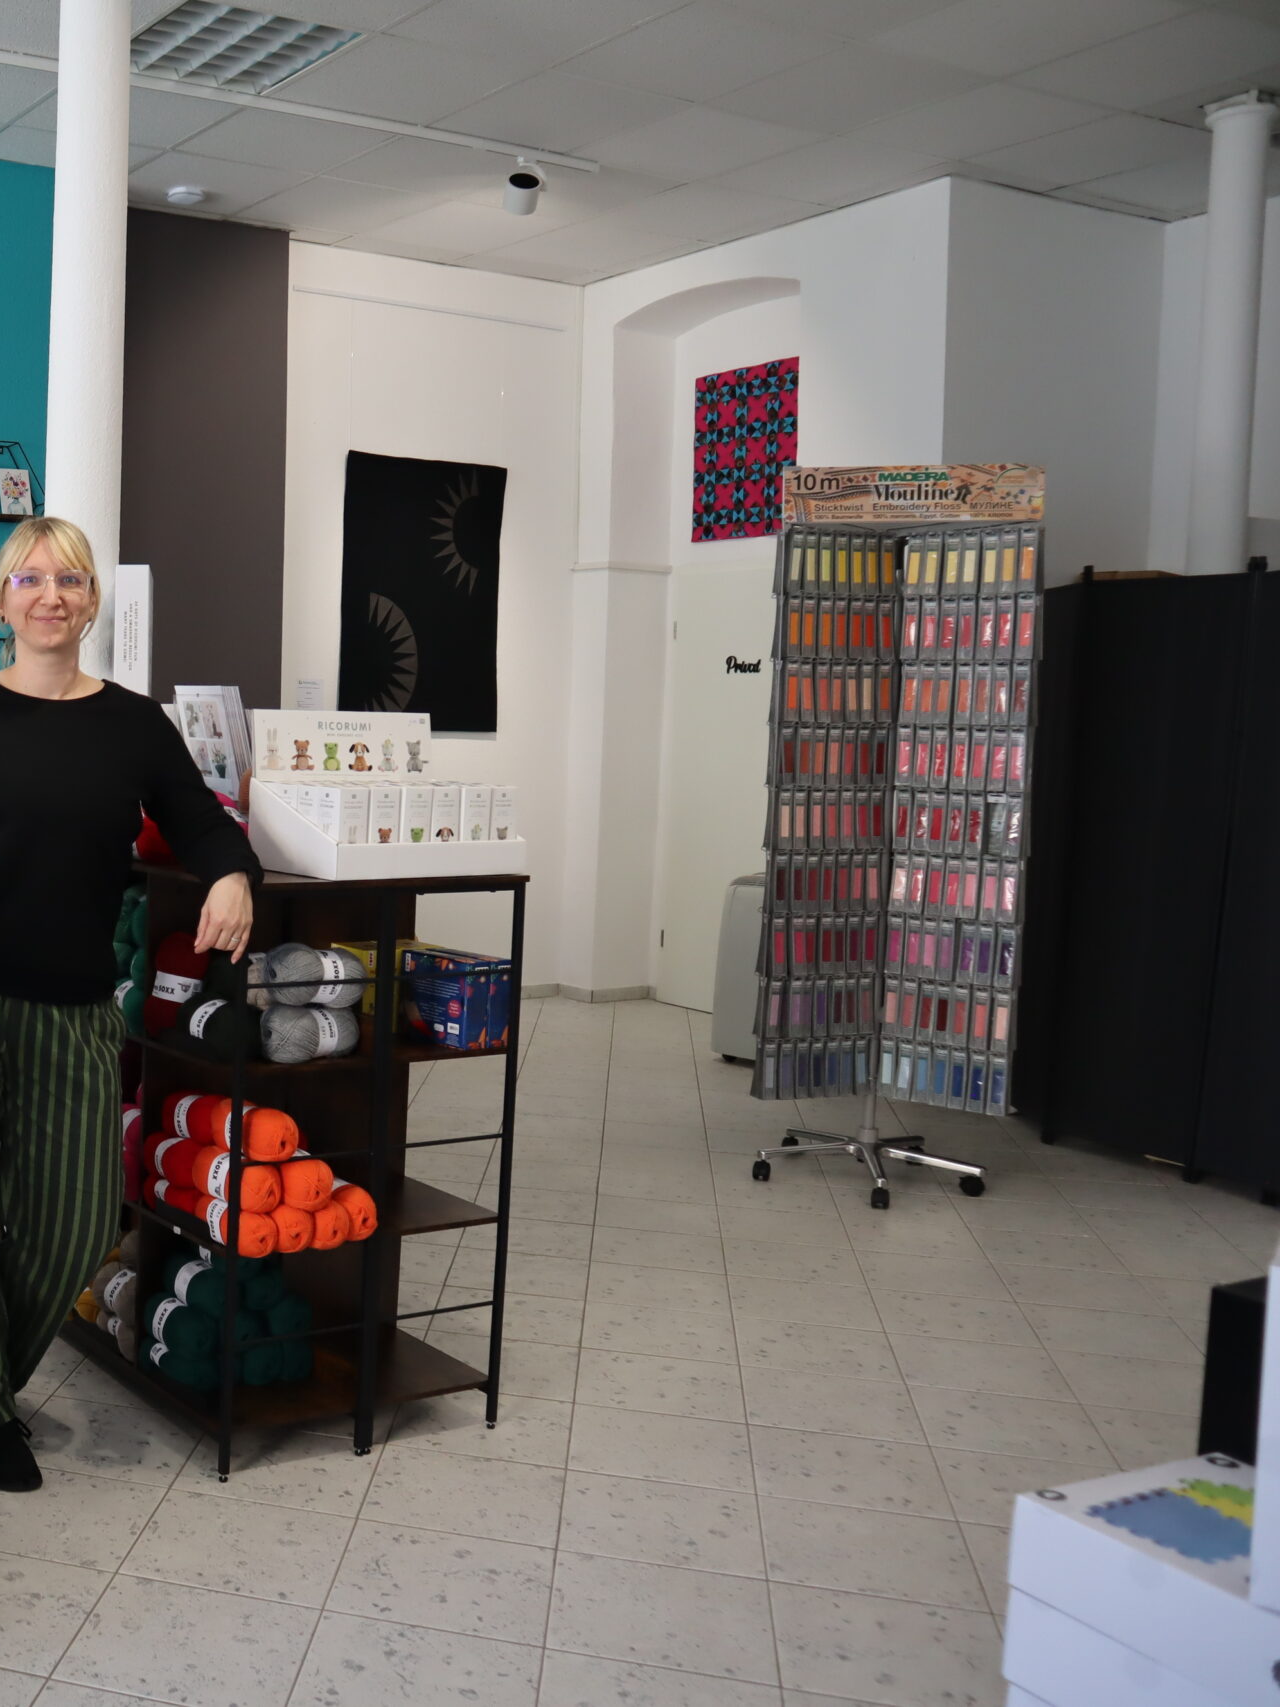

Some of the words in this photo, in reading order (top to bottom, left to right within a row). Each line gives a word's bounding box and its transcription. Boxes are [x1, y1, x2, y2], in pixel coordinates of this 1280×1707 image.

[793, 474, 816, 491] 10
[821, 477, 839, 490] m
[878, 470, 949, 482] MADEIRA
[814, 503, 864, 512] Sticktwist
[872, 502, 932, 512] Embroidery
[934, 502, 962, 510] Floss
[969, 501, 1014, 510] МУЛИНЕ
[725, 655, 762, 675] Privat
[317, 720, 372, 731] RICORUMI
[332, 960, 340, 979] SOXX
[158, 985, 175, 995] SOXX
[197, 1011, 208, 1028] SOXX
[212, 1160, 222, 1180] SOXX
[109, 1282, 121, 1298] SOXX
[158, 1308, 168, 1325] SOXX
